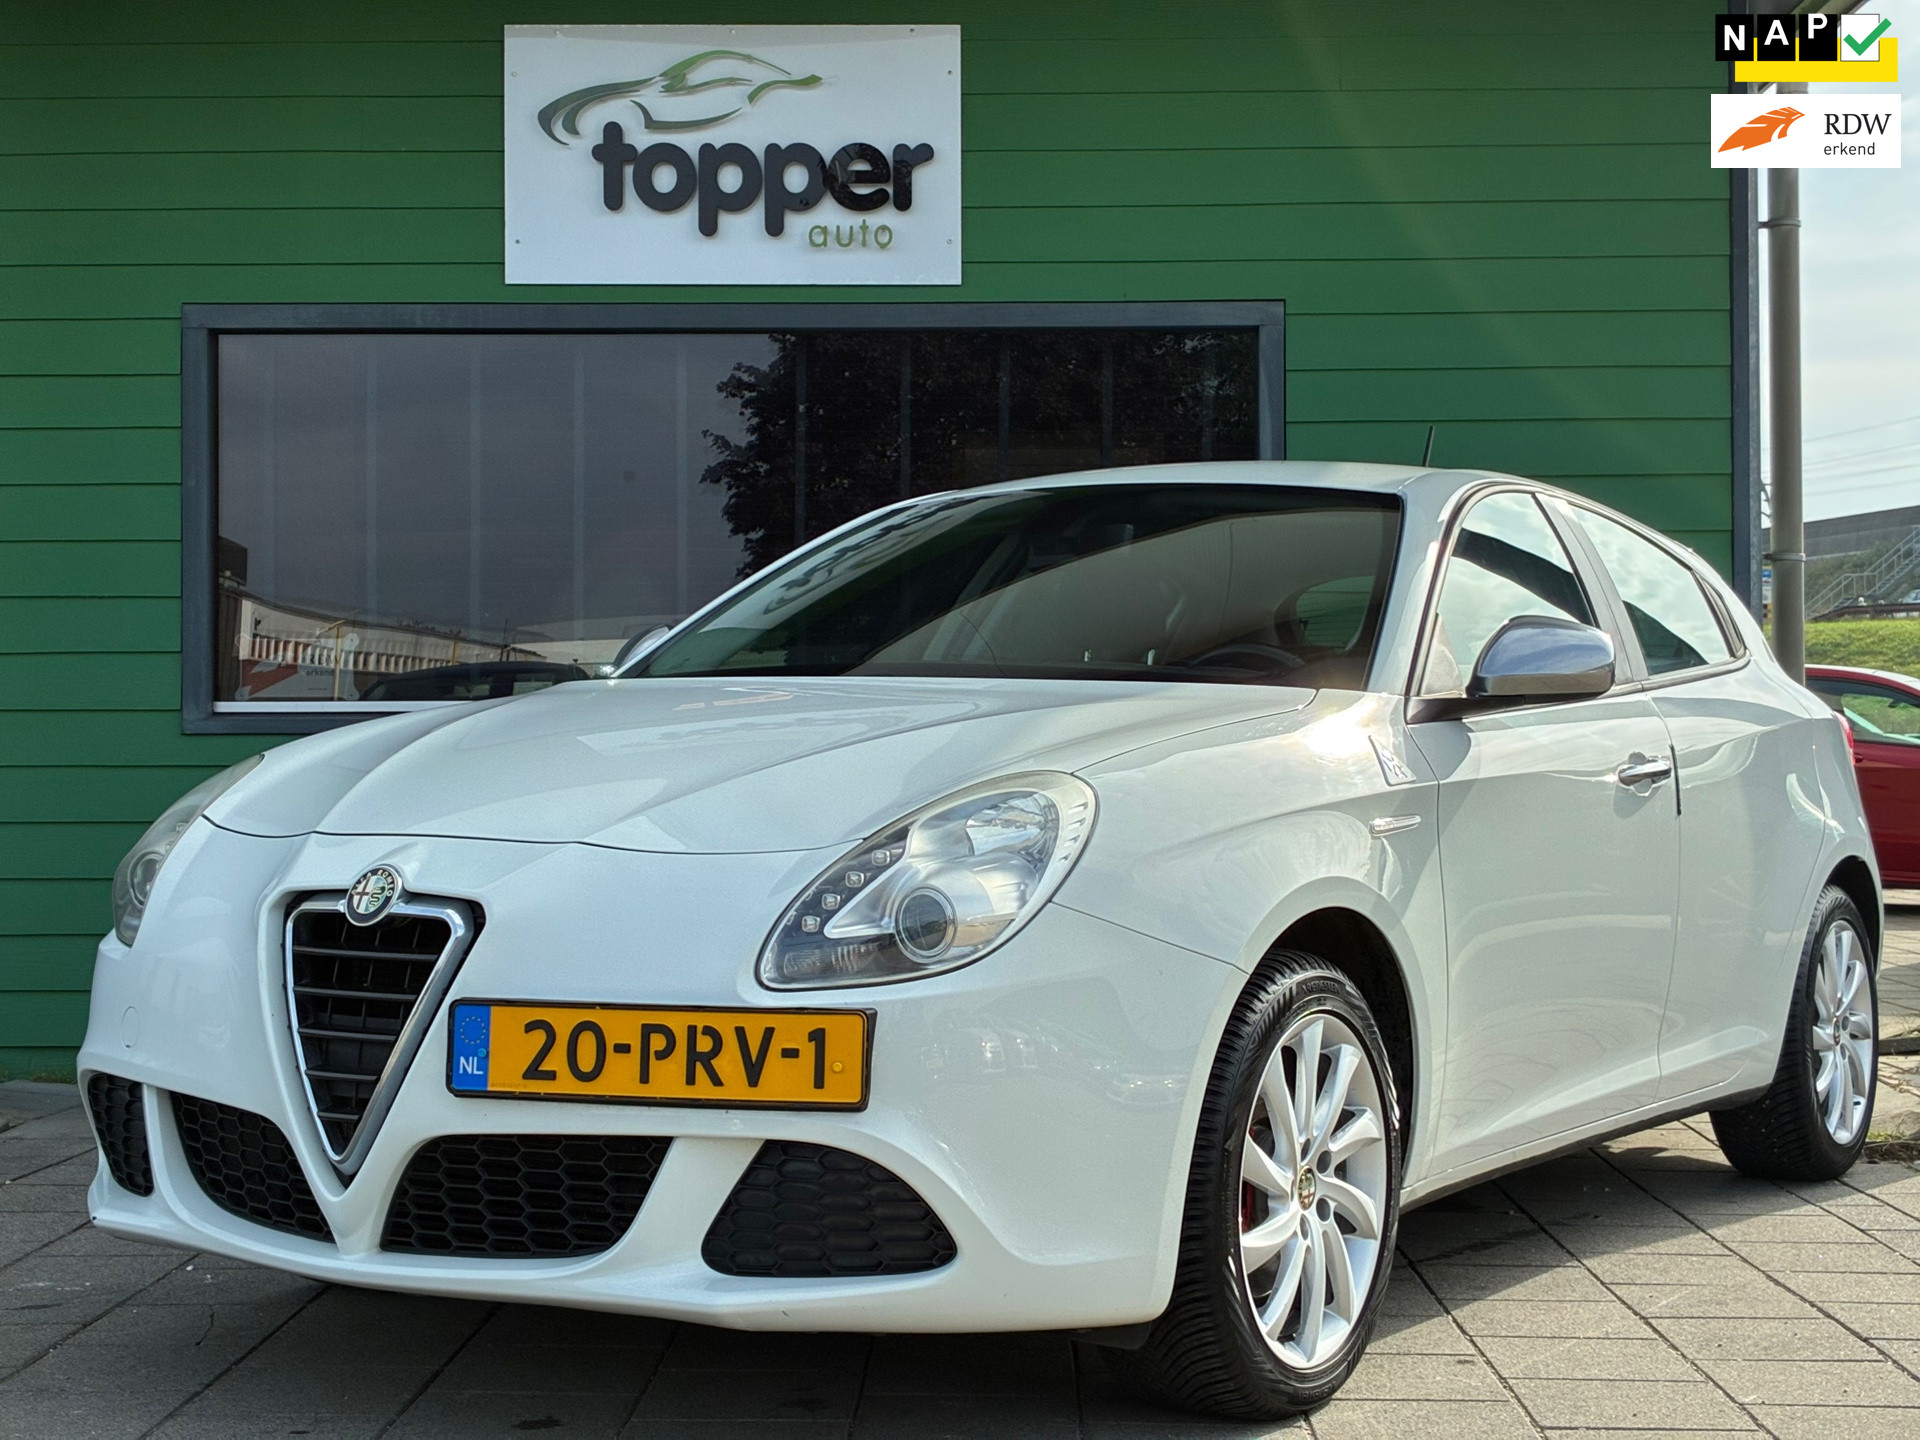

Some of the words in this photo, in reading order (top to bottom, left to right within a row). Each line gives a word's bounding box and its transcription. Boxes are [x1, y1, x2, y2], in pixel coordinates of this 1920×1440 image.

[591, 121, 935, 238] topper
[808, 218, 894, 250] auto
[377, 869, 394, 897] ROMEO
[458, 1055, 484, 1075] NL
[521, 1018, 827, 1090] 20-PRV-1
